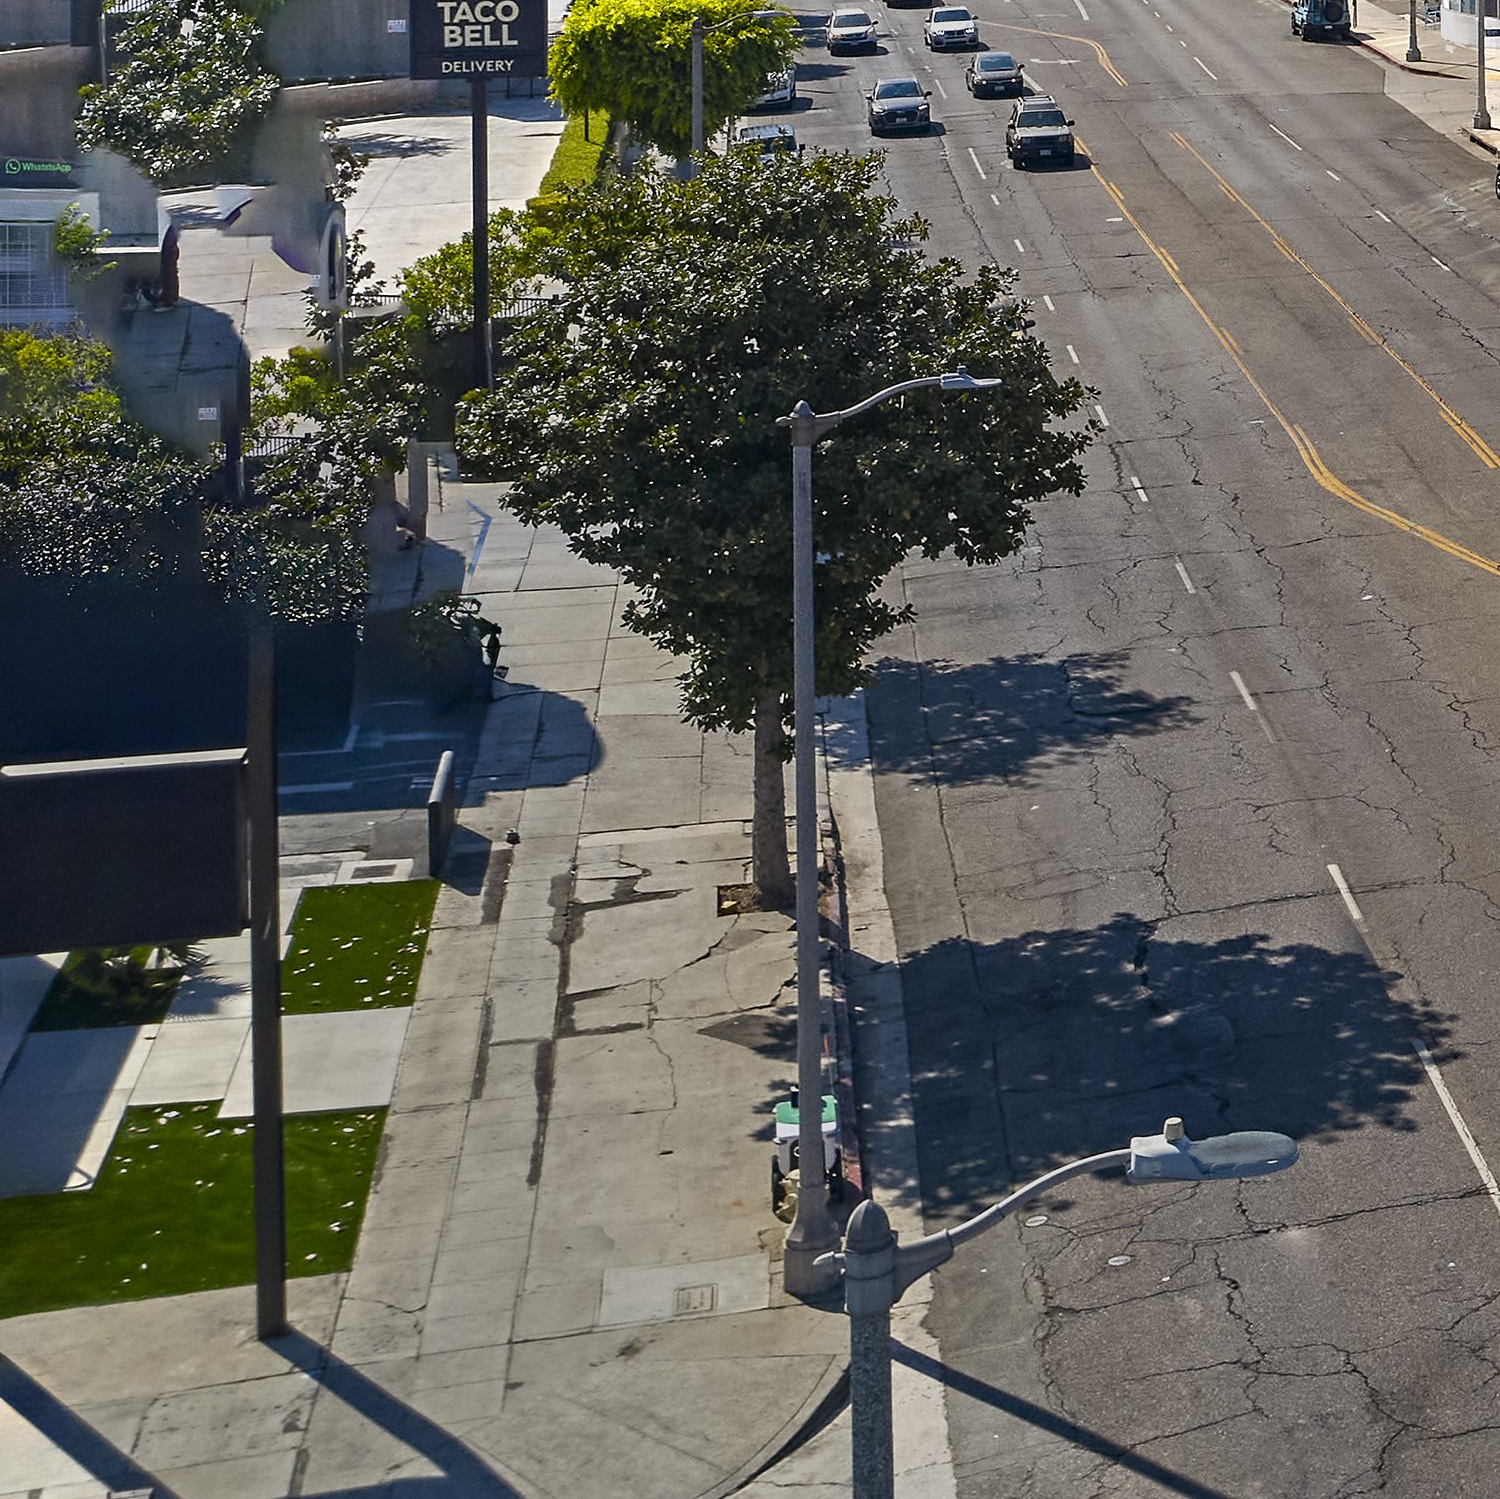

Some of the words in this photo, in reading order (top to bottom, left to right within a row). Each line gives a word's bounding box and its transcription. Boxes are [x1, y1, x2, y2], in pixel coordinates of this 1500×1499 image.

[437, 0, 519, 23] TACO
[444, 24, 518, 47] BELL
[442, 60, 514, 73] DELIVERY
